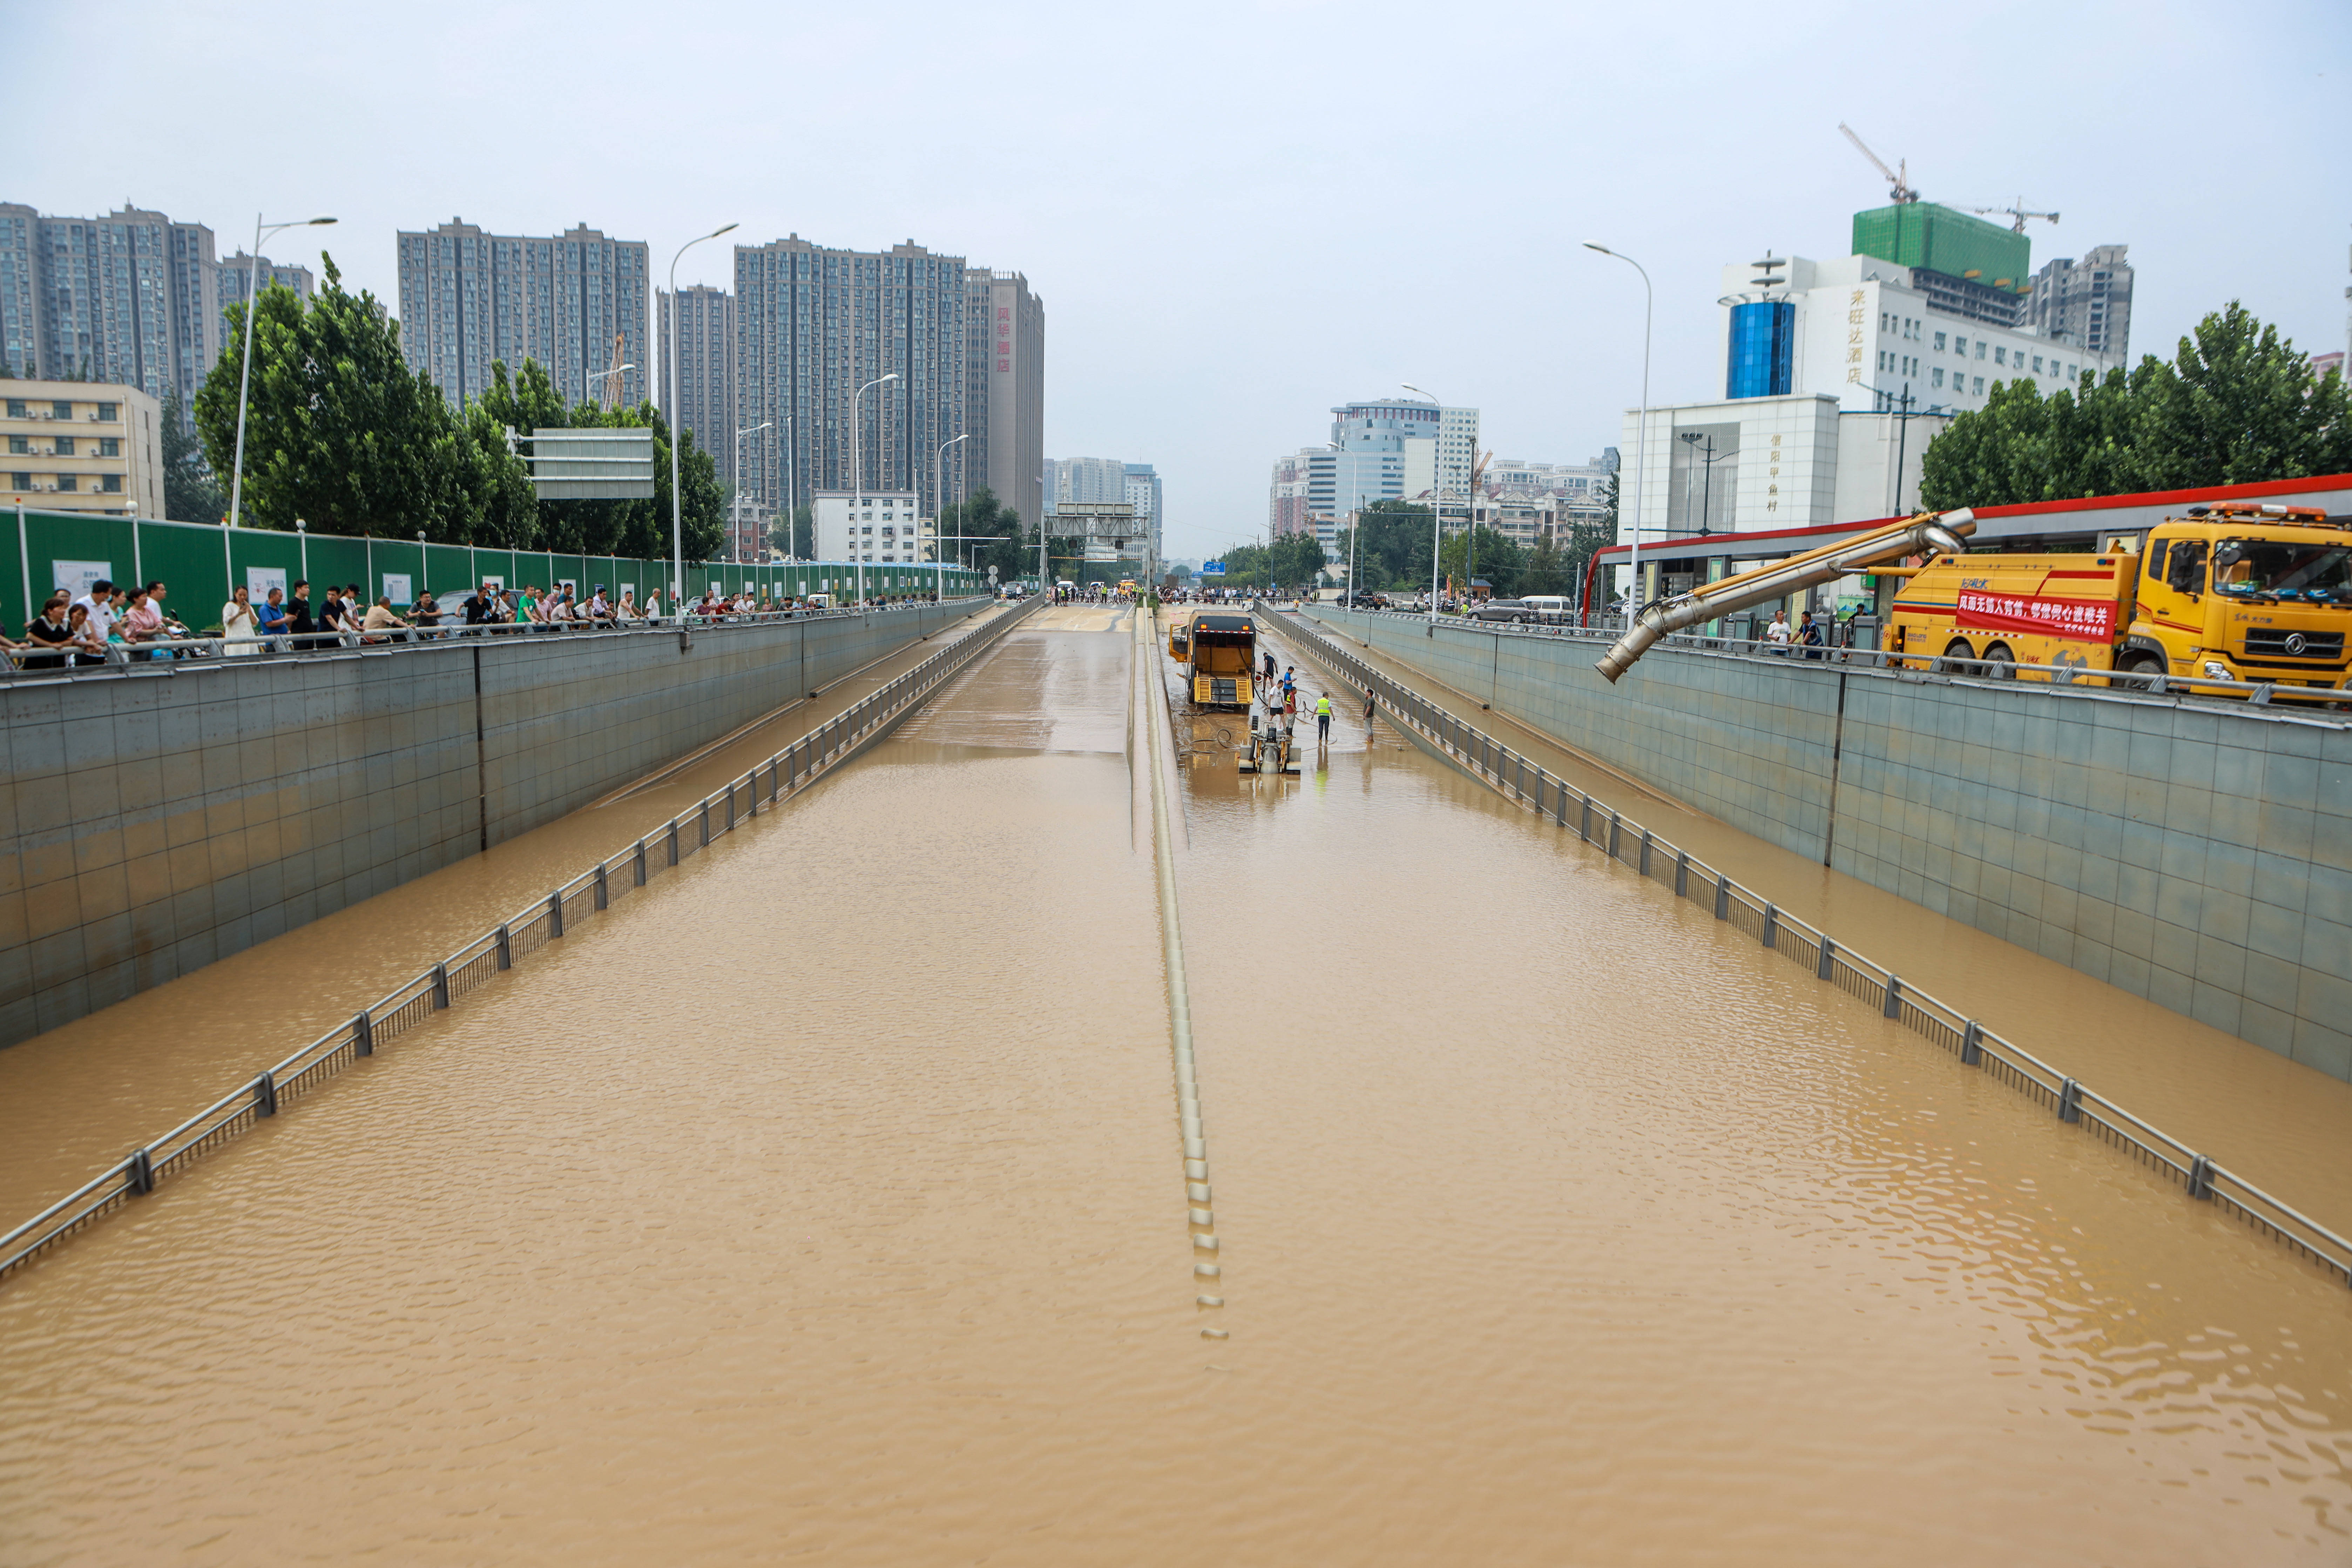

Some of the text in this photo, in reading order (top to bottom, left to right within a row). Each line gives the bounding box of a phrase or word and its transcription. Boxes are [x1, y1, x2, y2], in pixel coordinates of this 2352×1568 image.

[997, 307, 1010, 372] 风华酒店
[1846, 289, 1865, 383] 来旺达酒店
[1766, 433, 1782, 512] 信阳甲鱼村
